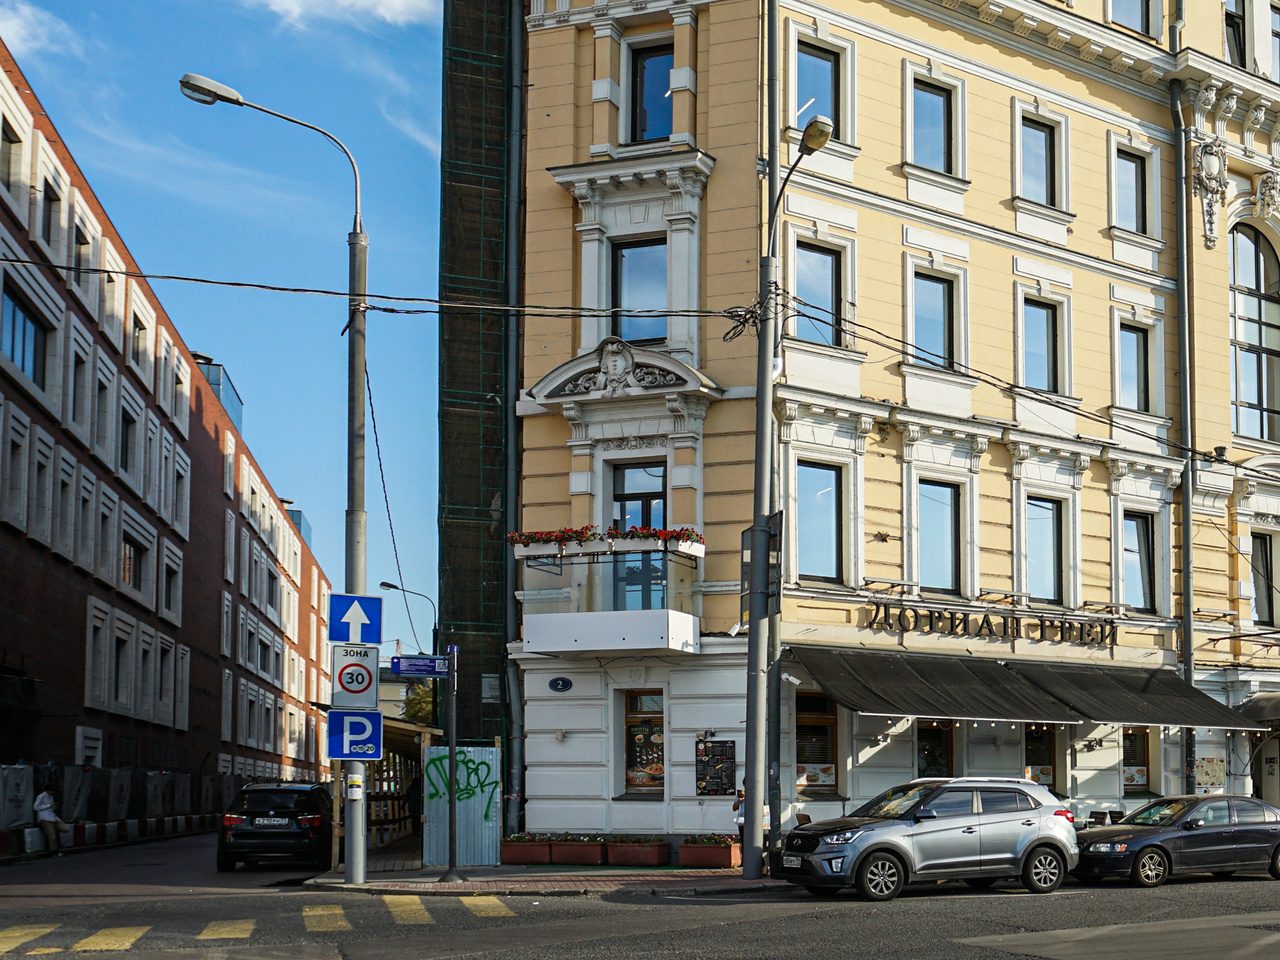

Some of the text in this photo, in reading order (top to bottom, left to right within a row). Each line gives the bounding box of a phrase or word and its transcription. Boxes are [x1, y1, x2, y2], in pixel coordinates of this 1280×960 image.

[868, 602, 1119, 646] ДОРИАН ГРЕЙ
[342, 649, 369, 657] ЗОНА
[346, 672, 365, 685] 30
[557, 680, 563, 689] 2
[343, 716, 373, 754] P
